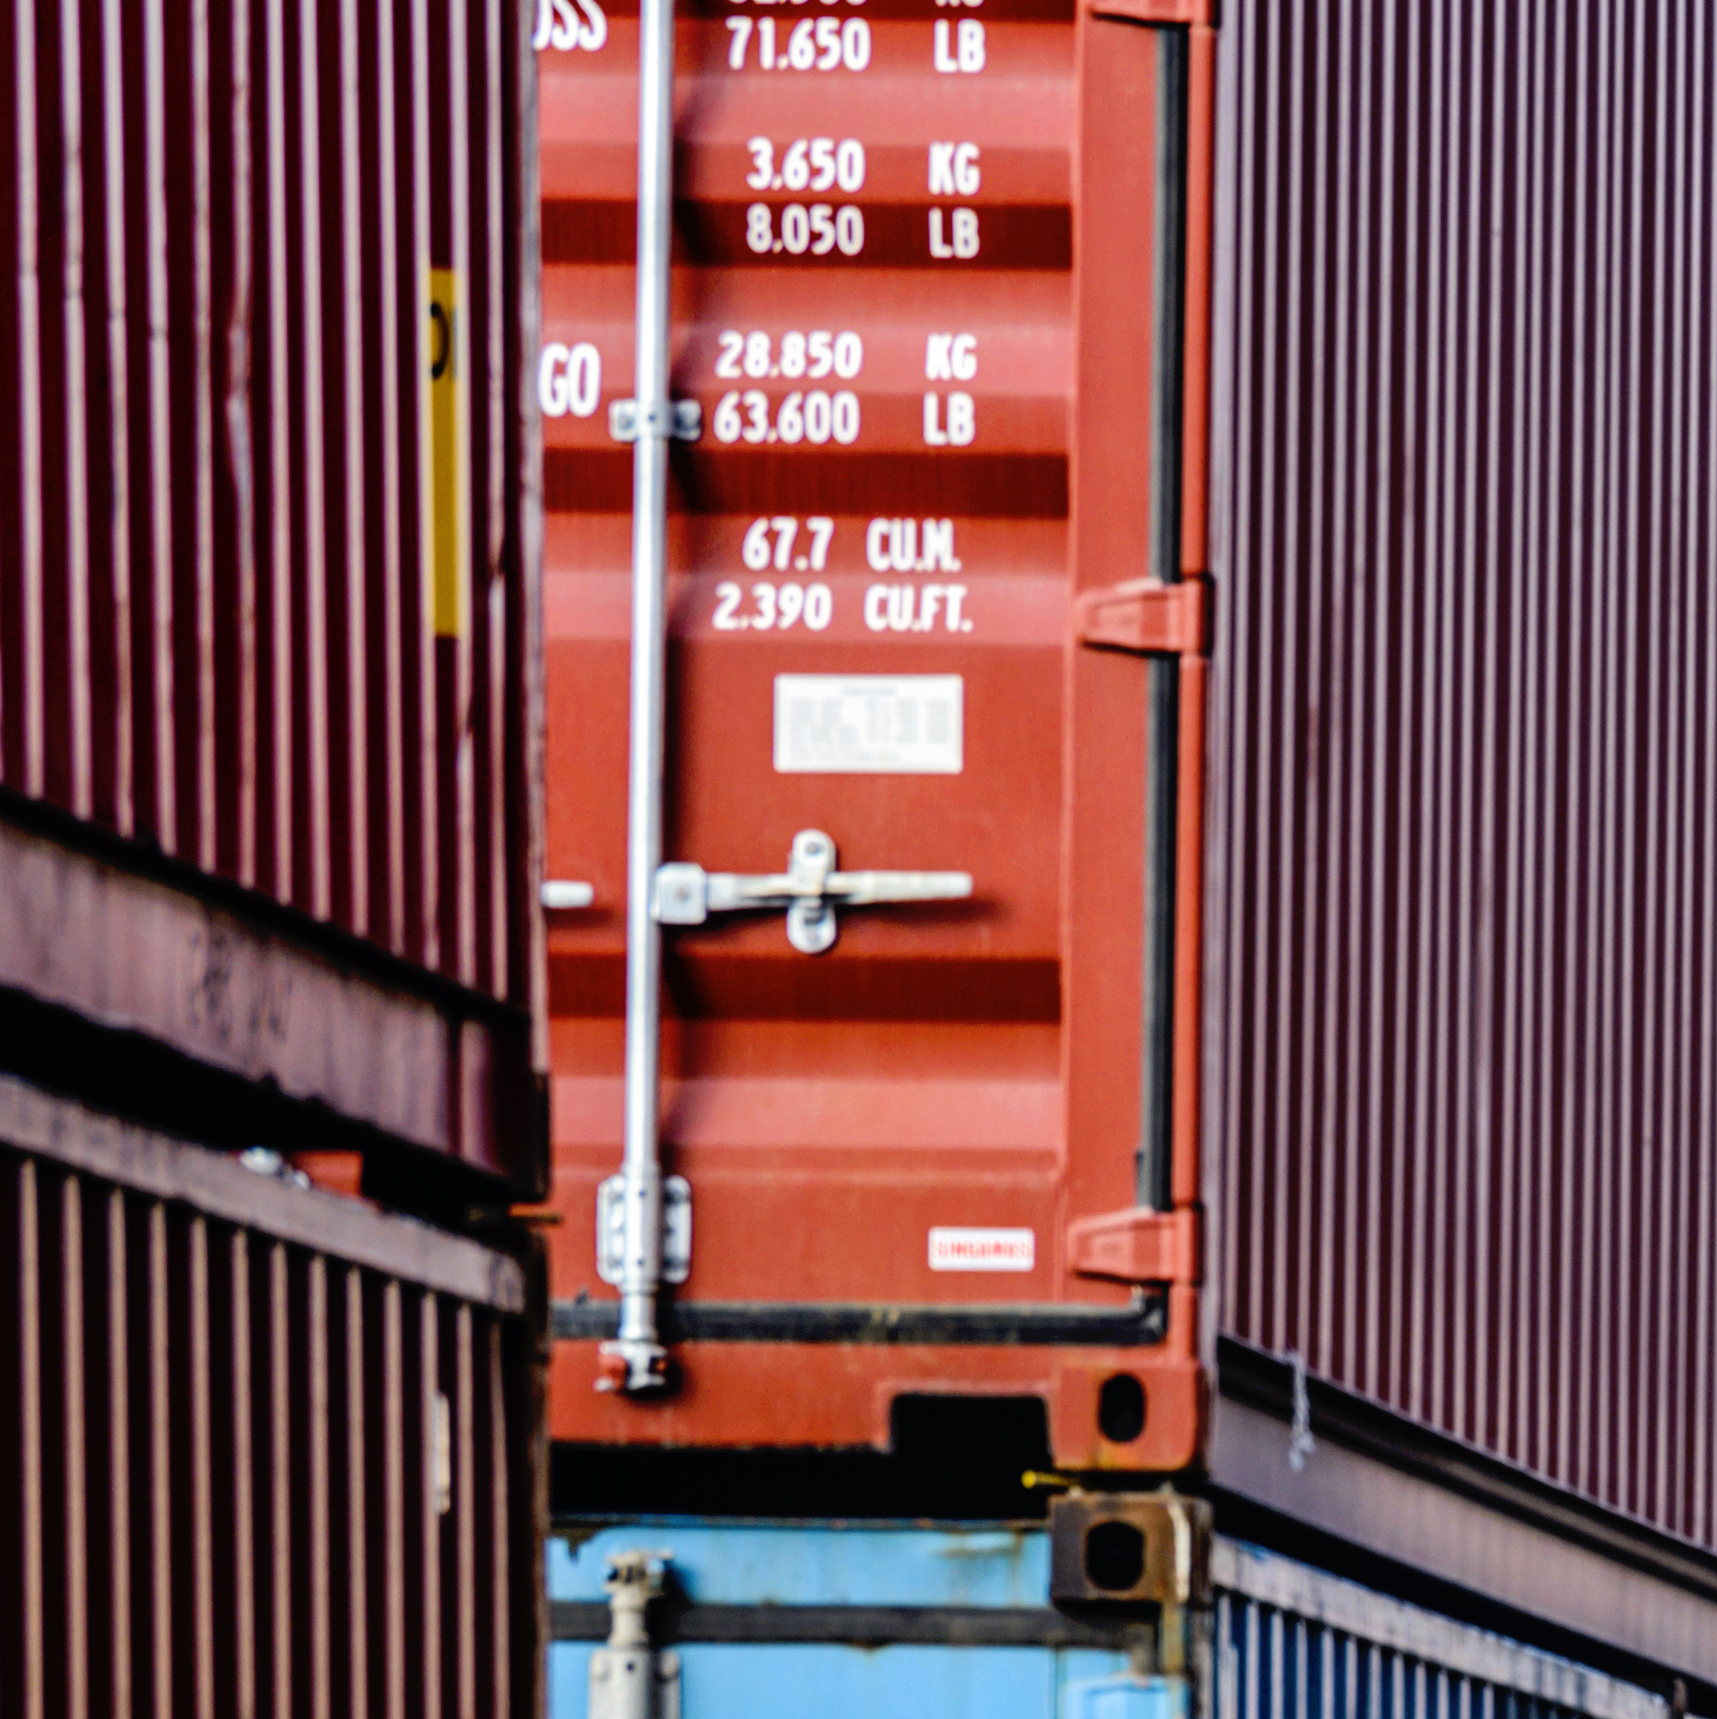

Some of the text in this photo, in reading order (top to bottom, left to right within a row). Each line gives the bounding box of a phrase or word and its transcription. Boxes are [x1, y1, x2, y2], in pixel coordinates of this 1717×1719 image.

[727, 17, 986, 78] 71.650 LB
[748, 136, 979, 194] 3.650 KG
[747, 204, 979, 258] 8.050 LB
[717, 331, 976, 379] 28.850 KG
[715, 390, 974, 445] 63.600 LB
[743, 518, 833, 571] 67.7
[714, 583, 972, 632] 2.390 CU.FT.
